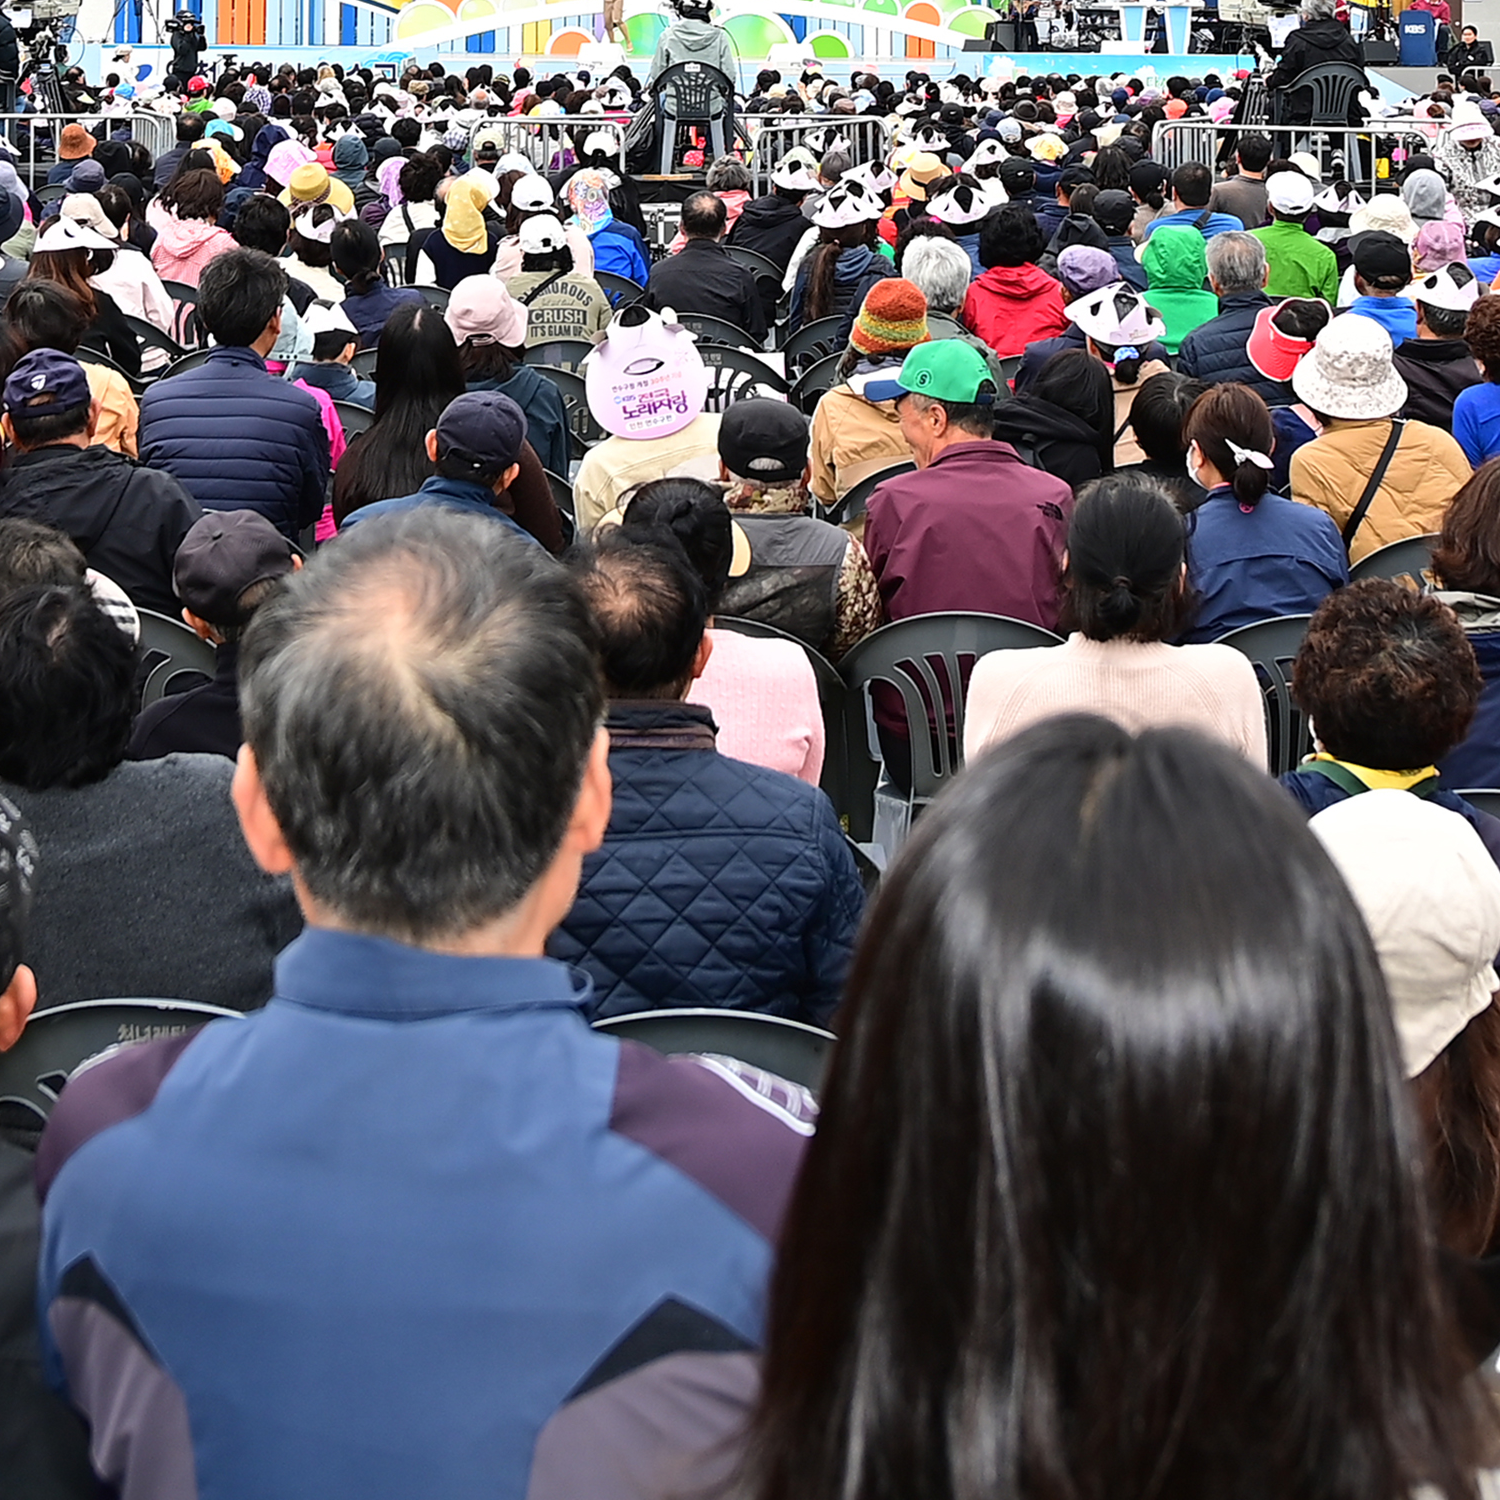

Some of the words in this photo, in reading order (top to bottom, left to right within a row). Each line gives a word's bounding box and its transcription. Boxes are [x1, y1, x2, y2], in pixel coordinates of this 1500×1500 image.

[1404, 24, 1426, 34] KBS
[531, 310, 584, 323] CRUSH
[530, 325, 546, 338] IT'S
[548, 325, 571, 337] GLAM
[638, 388, 670, 403] 전국
[622, 389, 689, 420] 노래자랑
